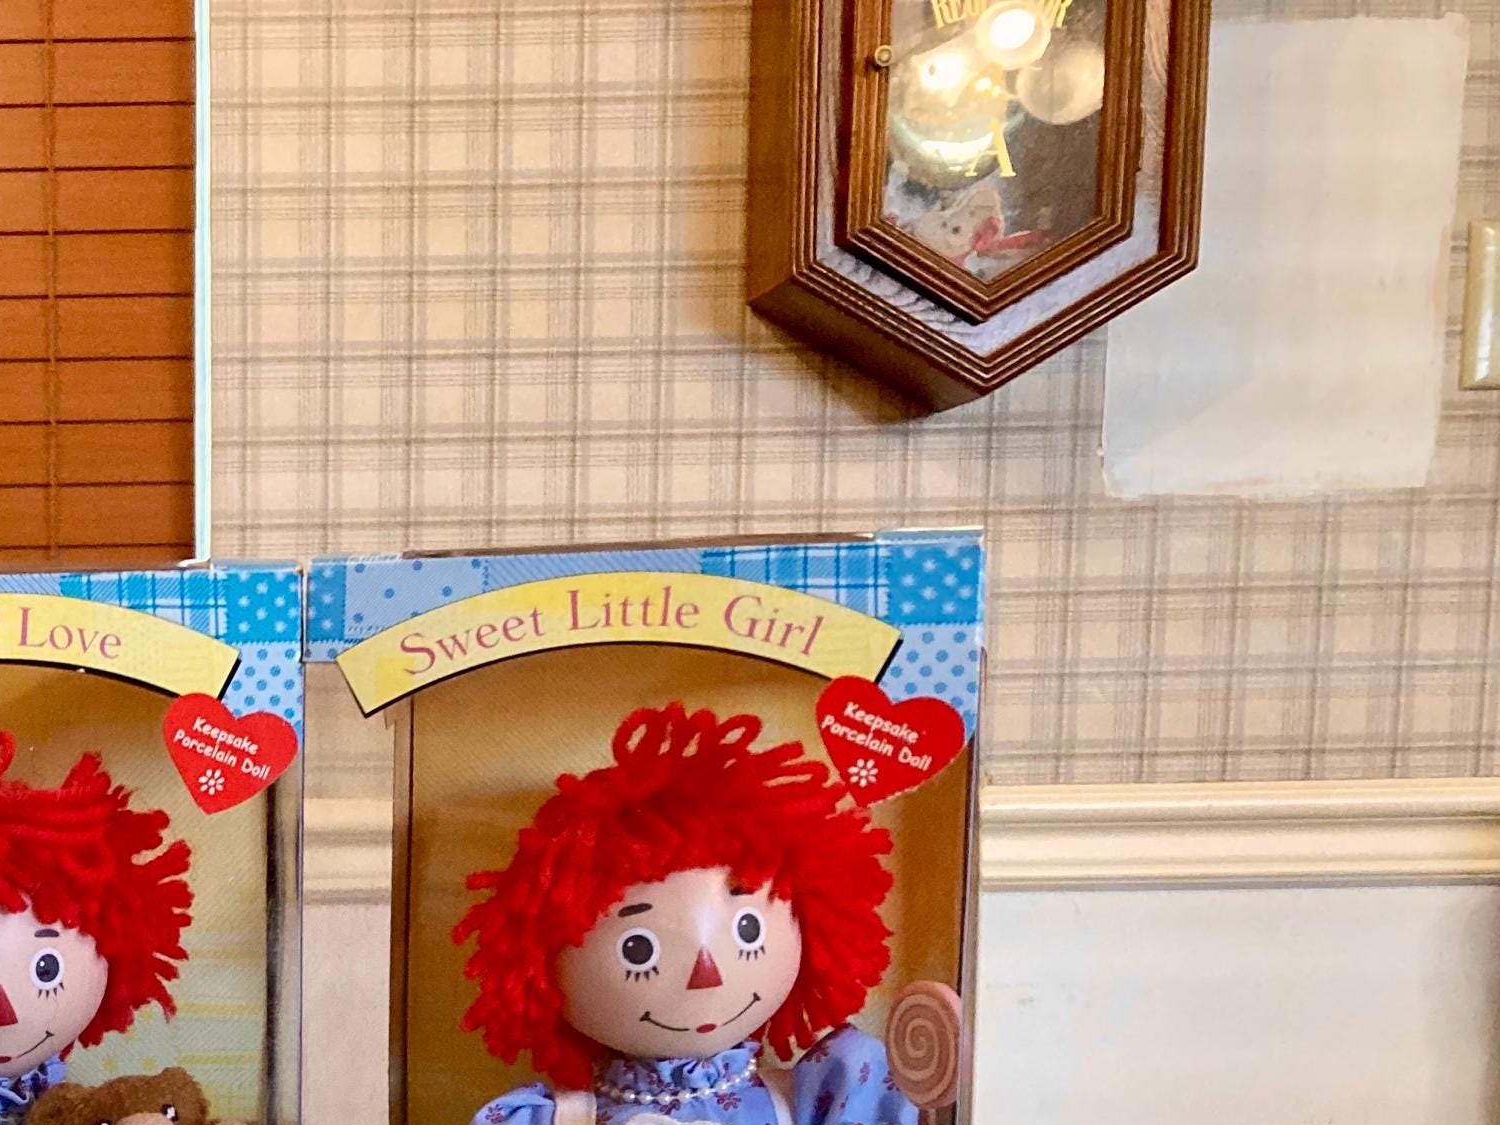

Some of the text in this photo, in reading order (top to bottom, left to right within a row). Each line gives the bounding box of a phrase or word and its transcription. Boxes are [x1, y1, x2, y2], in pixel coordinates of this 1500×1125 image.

[17, 607, 122, 659] Love
[400, 585, 826, 676] Sweet Little Girl
[192, 716, 259, 755] Keepsake
[821, 714, 932, 771] Porcelain Doll
[844, 702, 919, 744] Keepsake
[173, 728, 271, 780] Porcelain Doll
